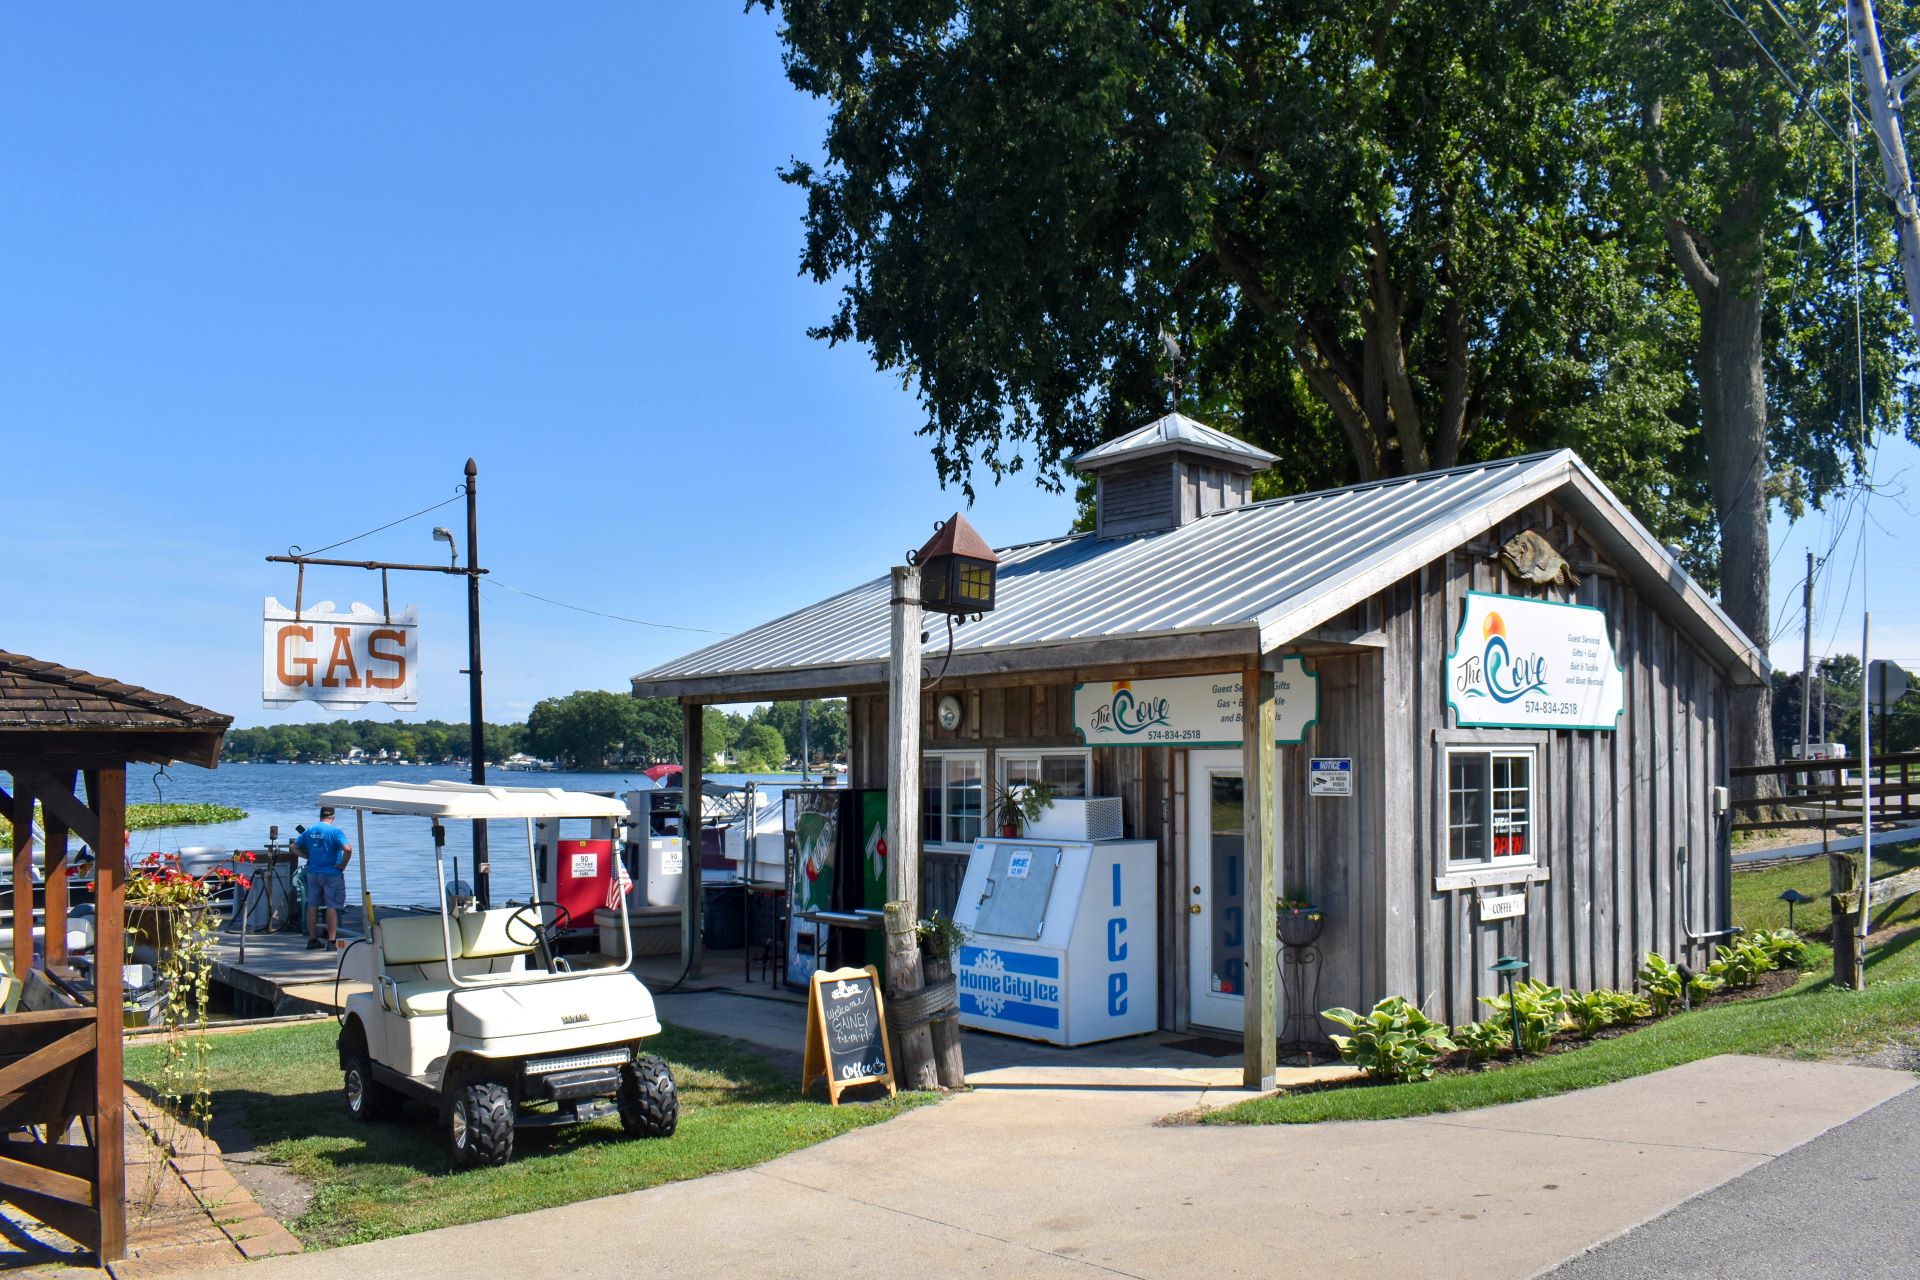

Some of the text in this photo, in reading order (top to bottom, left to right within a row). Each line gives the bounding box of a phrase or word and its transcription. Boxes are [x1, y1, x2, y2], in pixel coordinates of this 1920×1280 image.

[1567, 633, 1581, 643] Guest
[277, 625, 406, 689] GAS
[1457, 636, 1549, 704] The Cove
[1212, 684, 1233, 694] Guest
[1217, 699, 1231, 708] Gas
[1525, 701, 1578, 715] 574-834-2518
[1091, 689, 1170, 734] The Cove
[1220, 714, 1235, 723] and
[1148, 730, 1201, 740] 574-834-2518
[1319, 761, 1341, 770] NOTICE
[1493, 836, 1523, 856] OPEN
[1492, 902, 1512, 914] COFFEE
[960, 968, 1059, 1003] Home City Ice
[842, 1062, 872, 1079] Coffee
